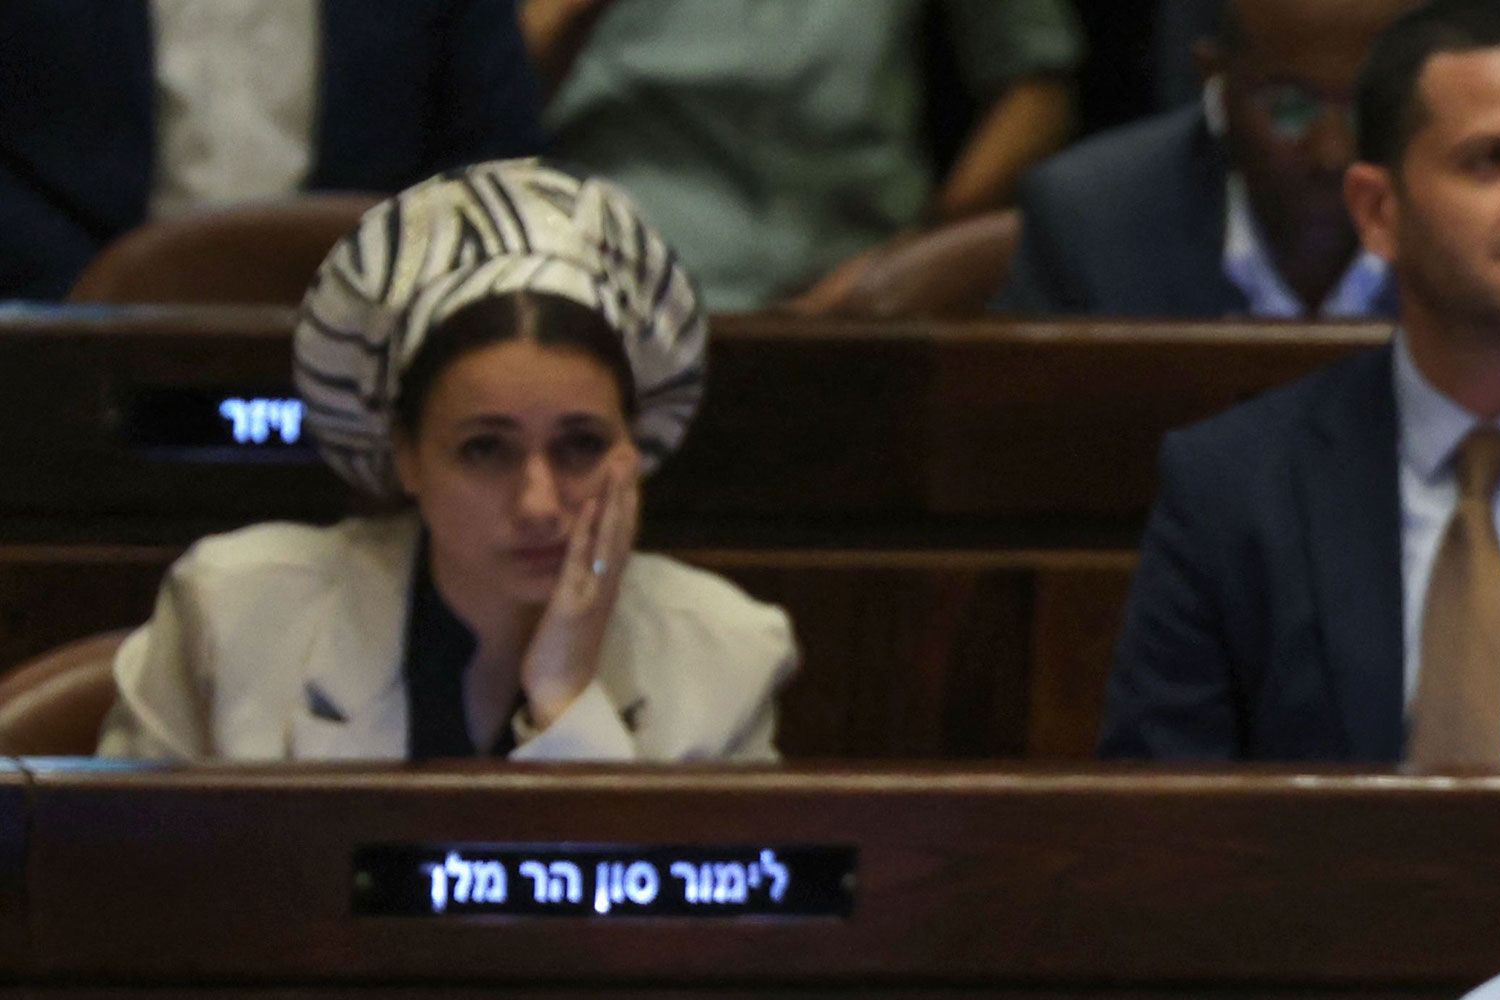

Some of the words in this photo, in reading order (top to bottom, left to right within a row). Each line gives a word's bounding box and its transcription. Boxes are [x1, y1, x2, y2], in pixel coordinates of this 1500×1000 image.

[519, 861, 582, 903] הר
[594, 862, 658, 914] סון
[671, 850, 788, 903] לימור
